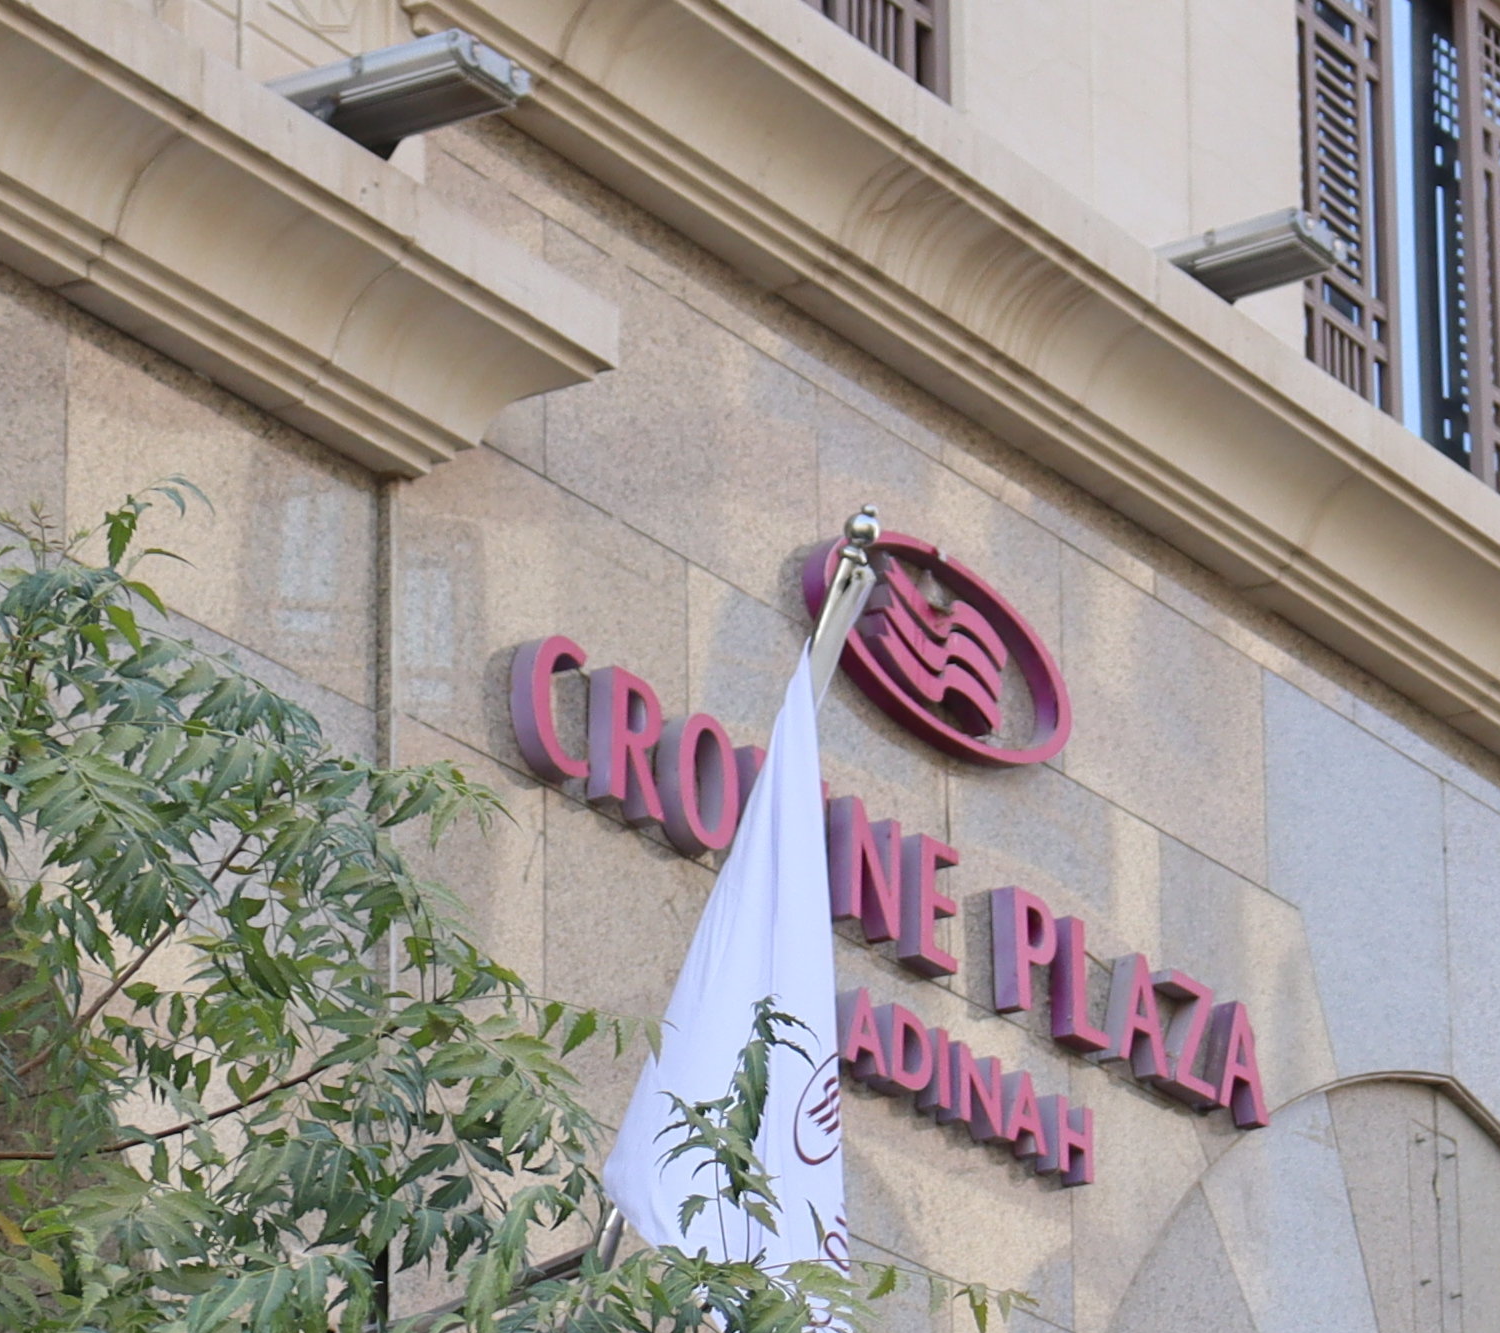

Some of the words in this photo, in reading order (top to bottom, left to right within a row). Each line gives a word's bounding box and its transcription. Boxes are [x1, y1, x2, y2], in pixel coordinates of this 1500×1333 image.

[510, 635, 959, 977] CRONE
[990, 886, 1270, 1128] PLAZA
[837, 986, 1095, 1187] ADINAH
